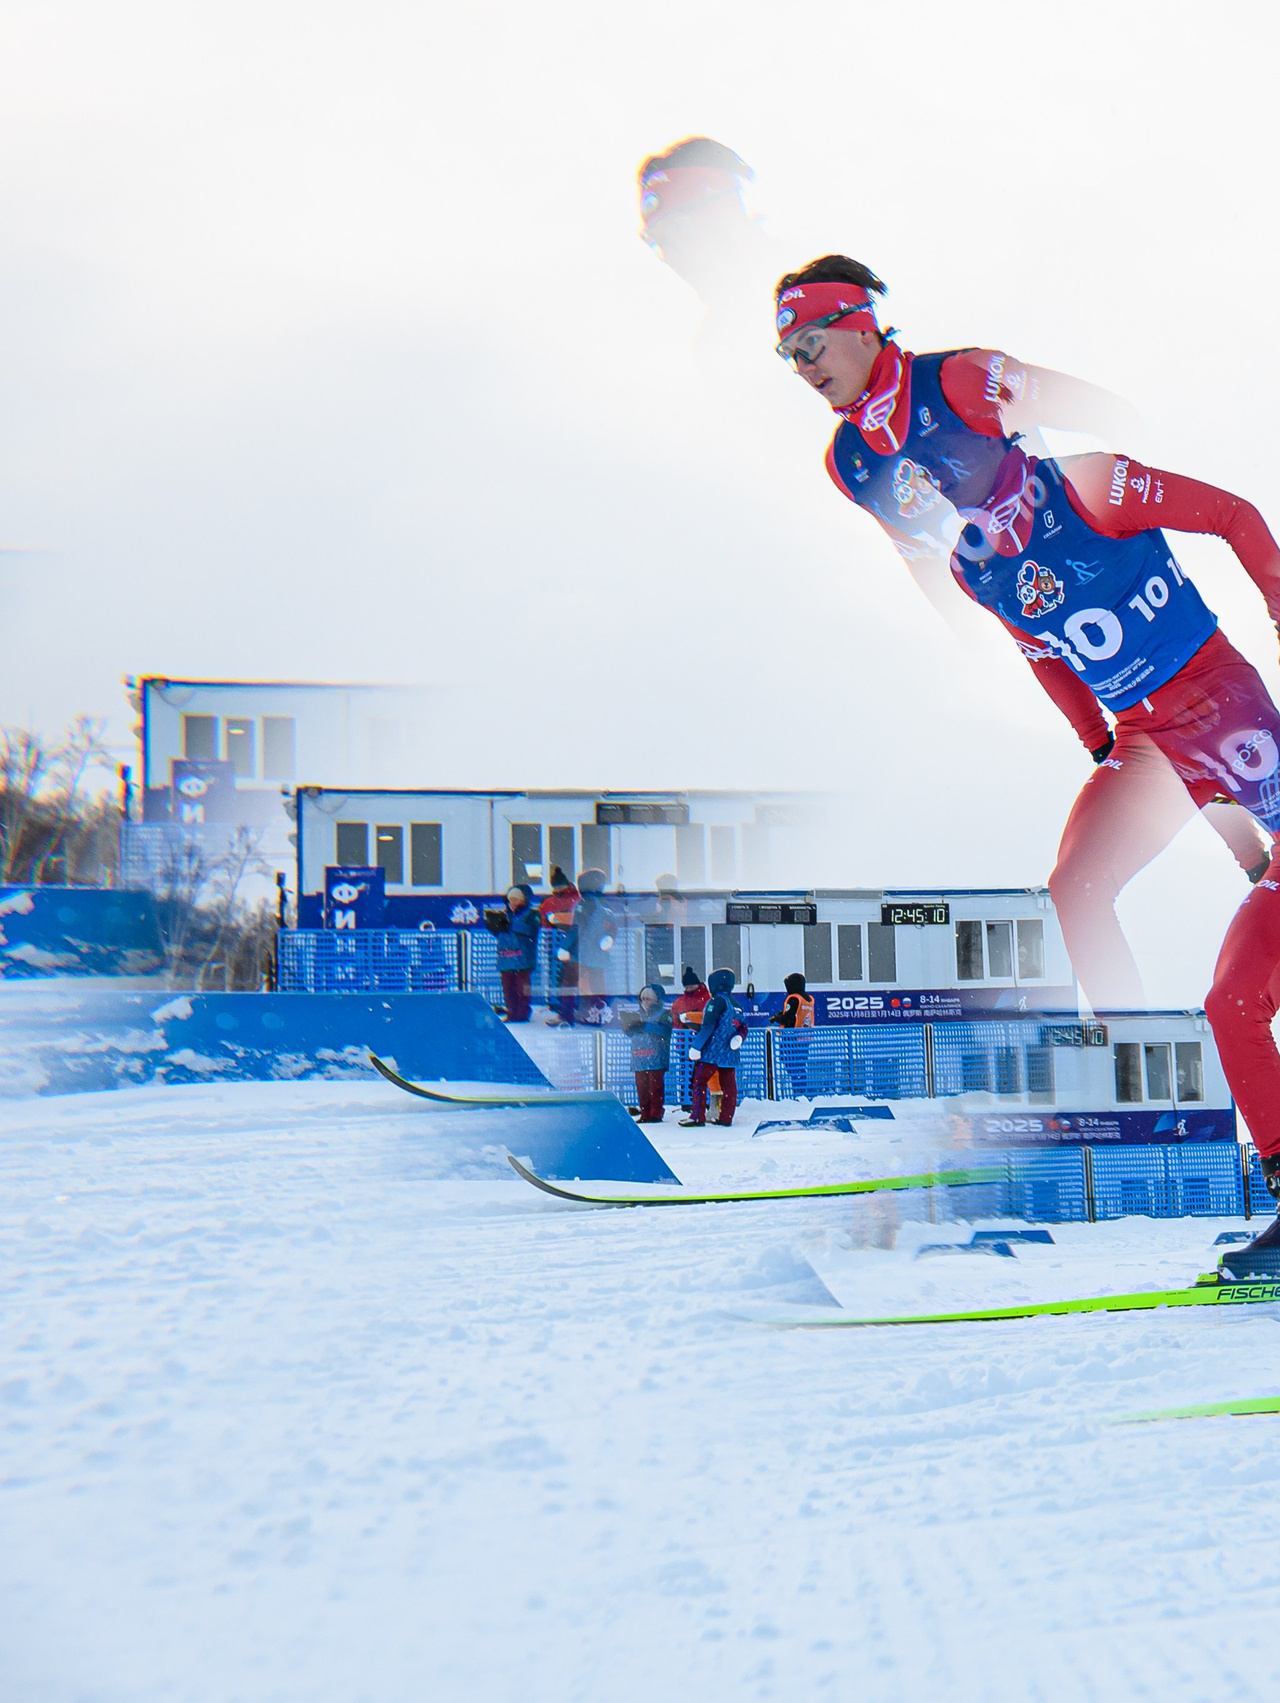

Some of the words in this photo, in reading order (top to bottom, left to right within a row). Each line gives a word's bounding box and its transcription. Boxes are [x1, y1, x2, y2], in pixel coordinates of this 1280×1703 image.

[1109, 459, 1129, 506] LUKOIL
[1128, 576, 1169, 622] 10
[1034, 607, 1123, 671] 10
[1232, 729, 1273, 771] BOSCO
[826, 996, 884, 1011] 2025
[920, 995, 940, 1003] 8-14
[985, 1119, 1044, 1133] 2025
